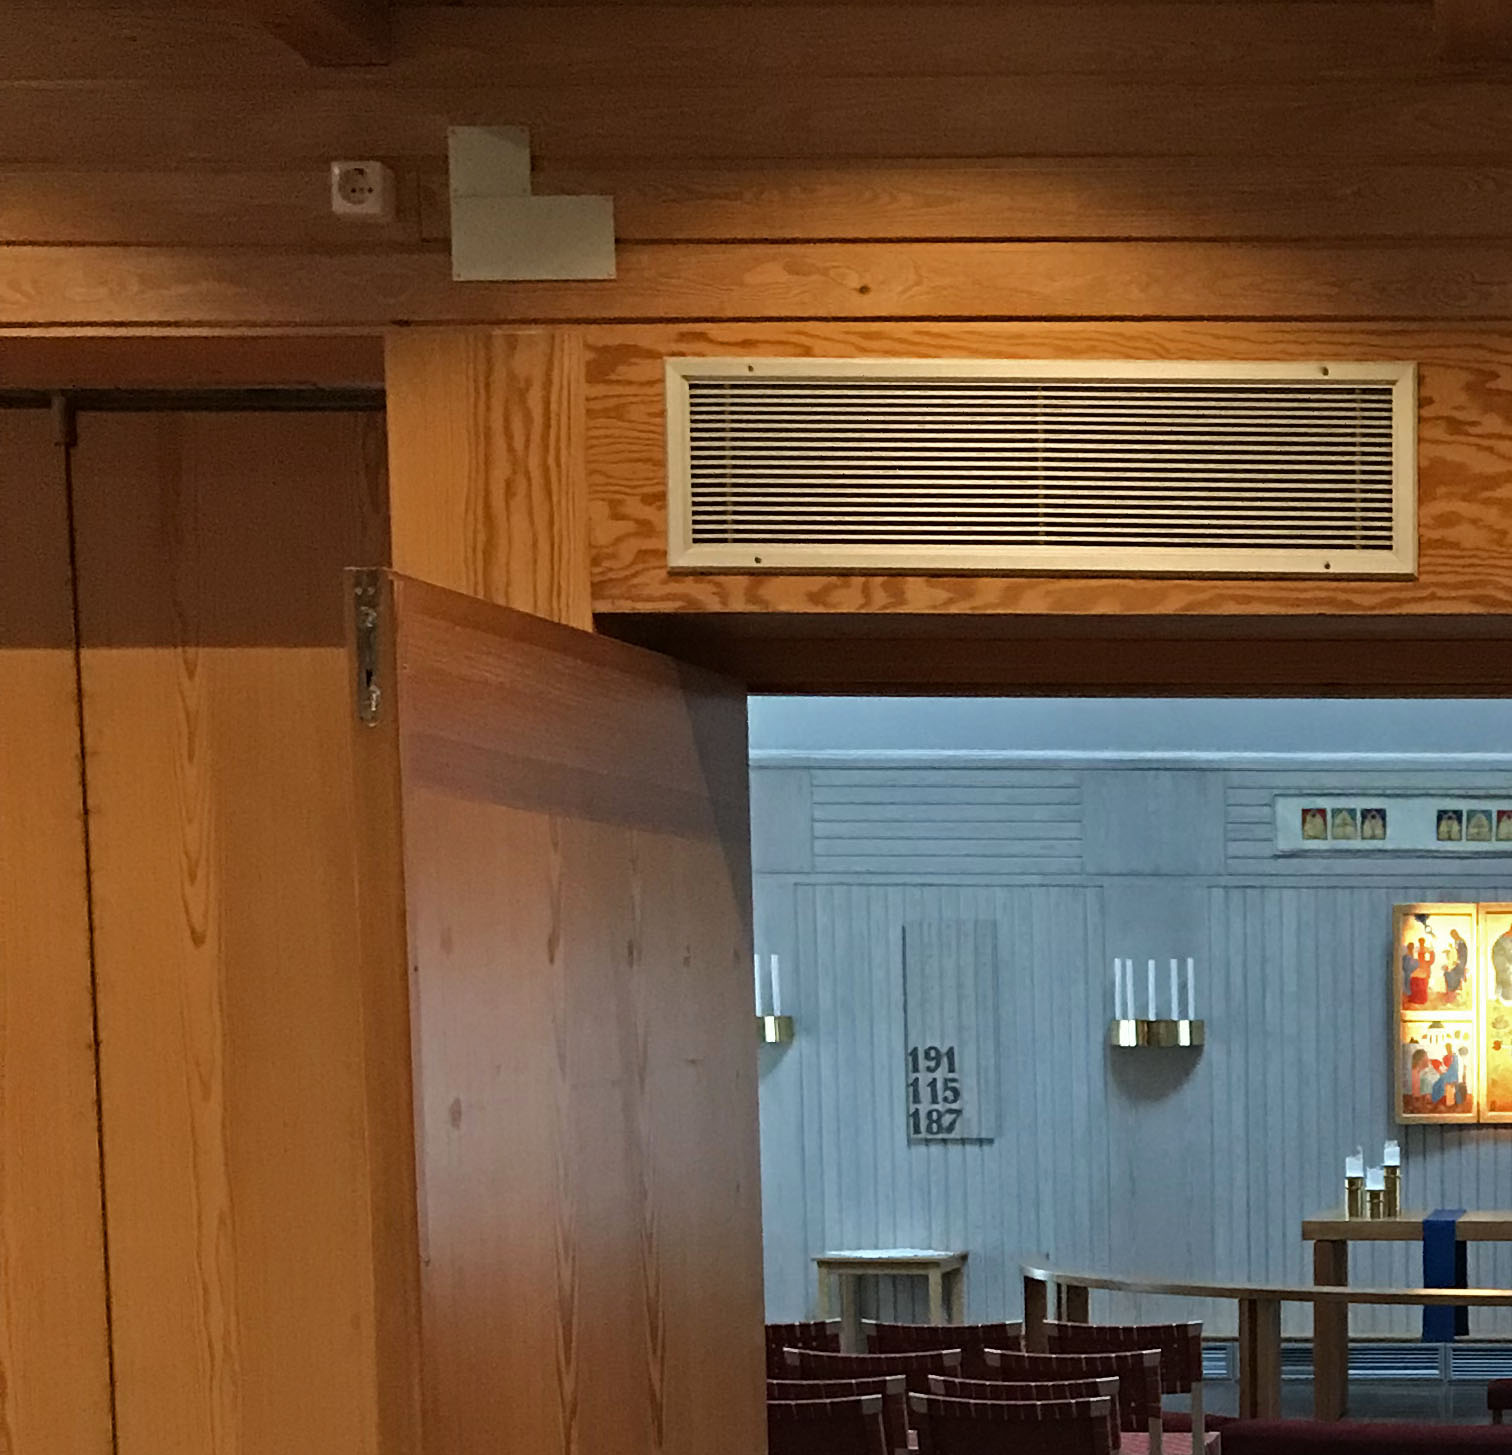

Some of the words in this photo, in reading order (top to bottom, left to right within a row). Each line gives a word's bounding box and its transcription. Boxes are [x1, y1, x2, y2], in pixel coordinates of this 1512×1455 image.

[908, 1046, 956, 1073] 191
[908, 1077, 961, 1104] 115
[909, 1108, 963, 1135] 187
